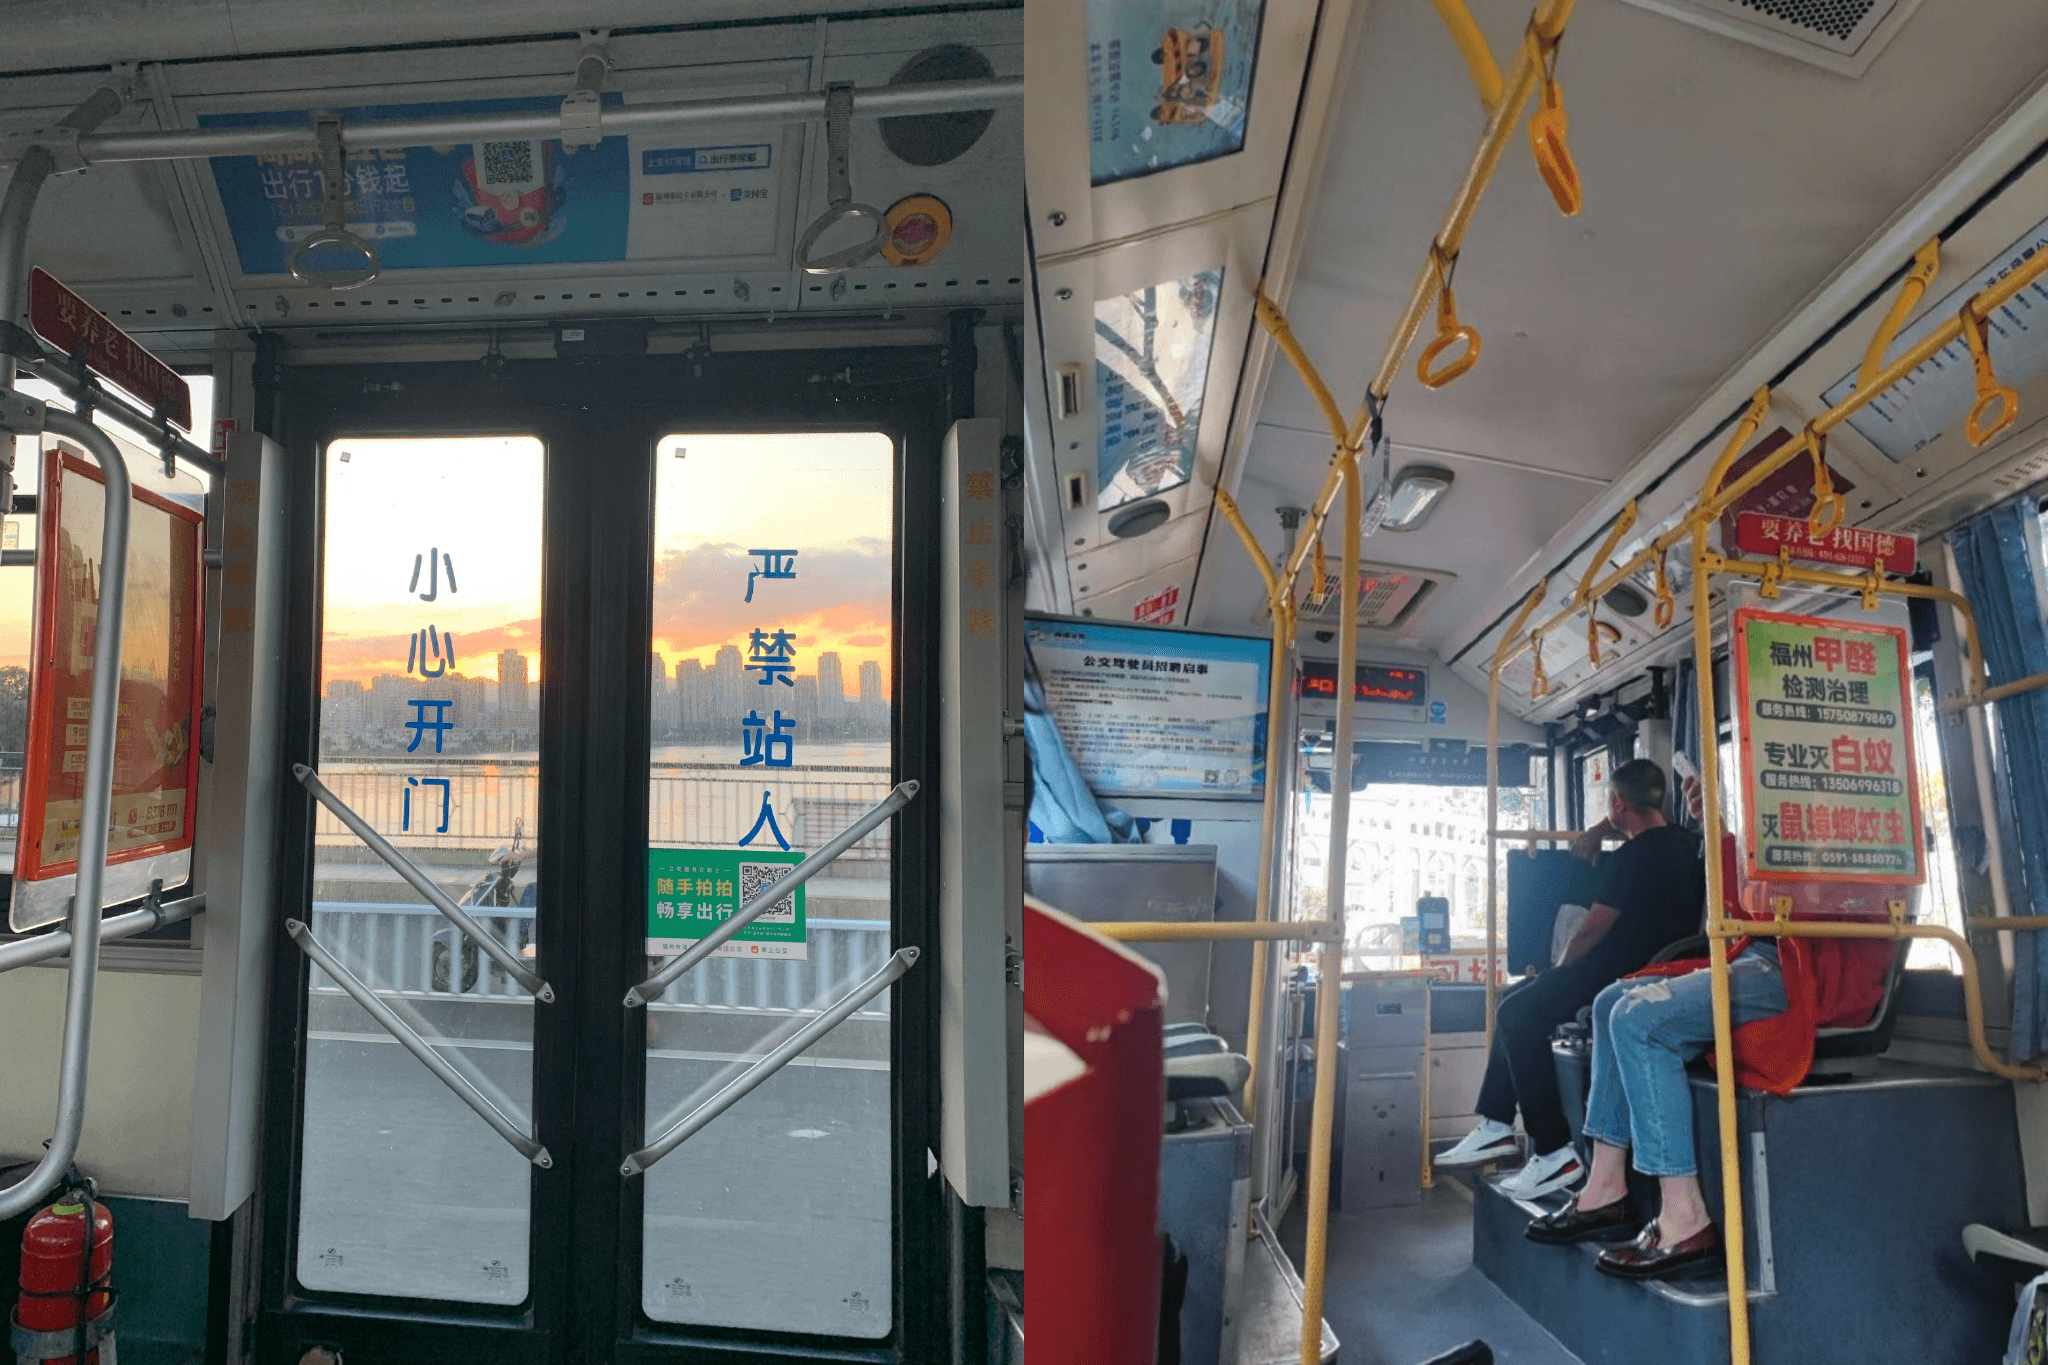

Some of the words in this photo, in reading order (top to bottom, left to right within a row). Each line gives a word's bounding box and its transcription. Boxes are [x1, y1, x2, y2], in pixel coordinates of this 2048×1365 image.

[743, 188, 768, 199] 支付宝
[1083, 655, 1209, 675] 公交驾驶员招聘启事
[1770, 637, 1875, 675] 福州甲醛
[402, 546, 458, 834] 小心开门
[738, 549, 799, 852] 严禁站人
[1782, 674, 1870, 704] 检测治理
[1764, 734, 1896, 774] 专业灭白蚁
[1822, 777, 1900, 794] 13506996318
[1762, 802, 1905, 842] 灭鼠蟑螂蚊虫
[656, 877, 733, 897] 随手拍拍
[656, 901, 734, 921] 畅享出行
